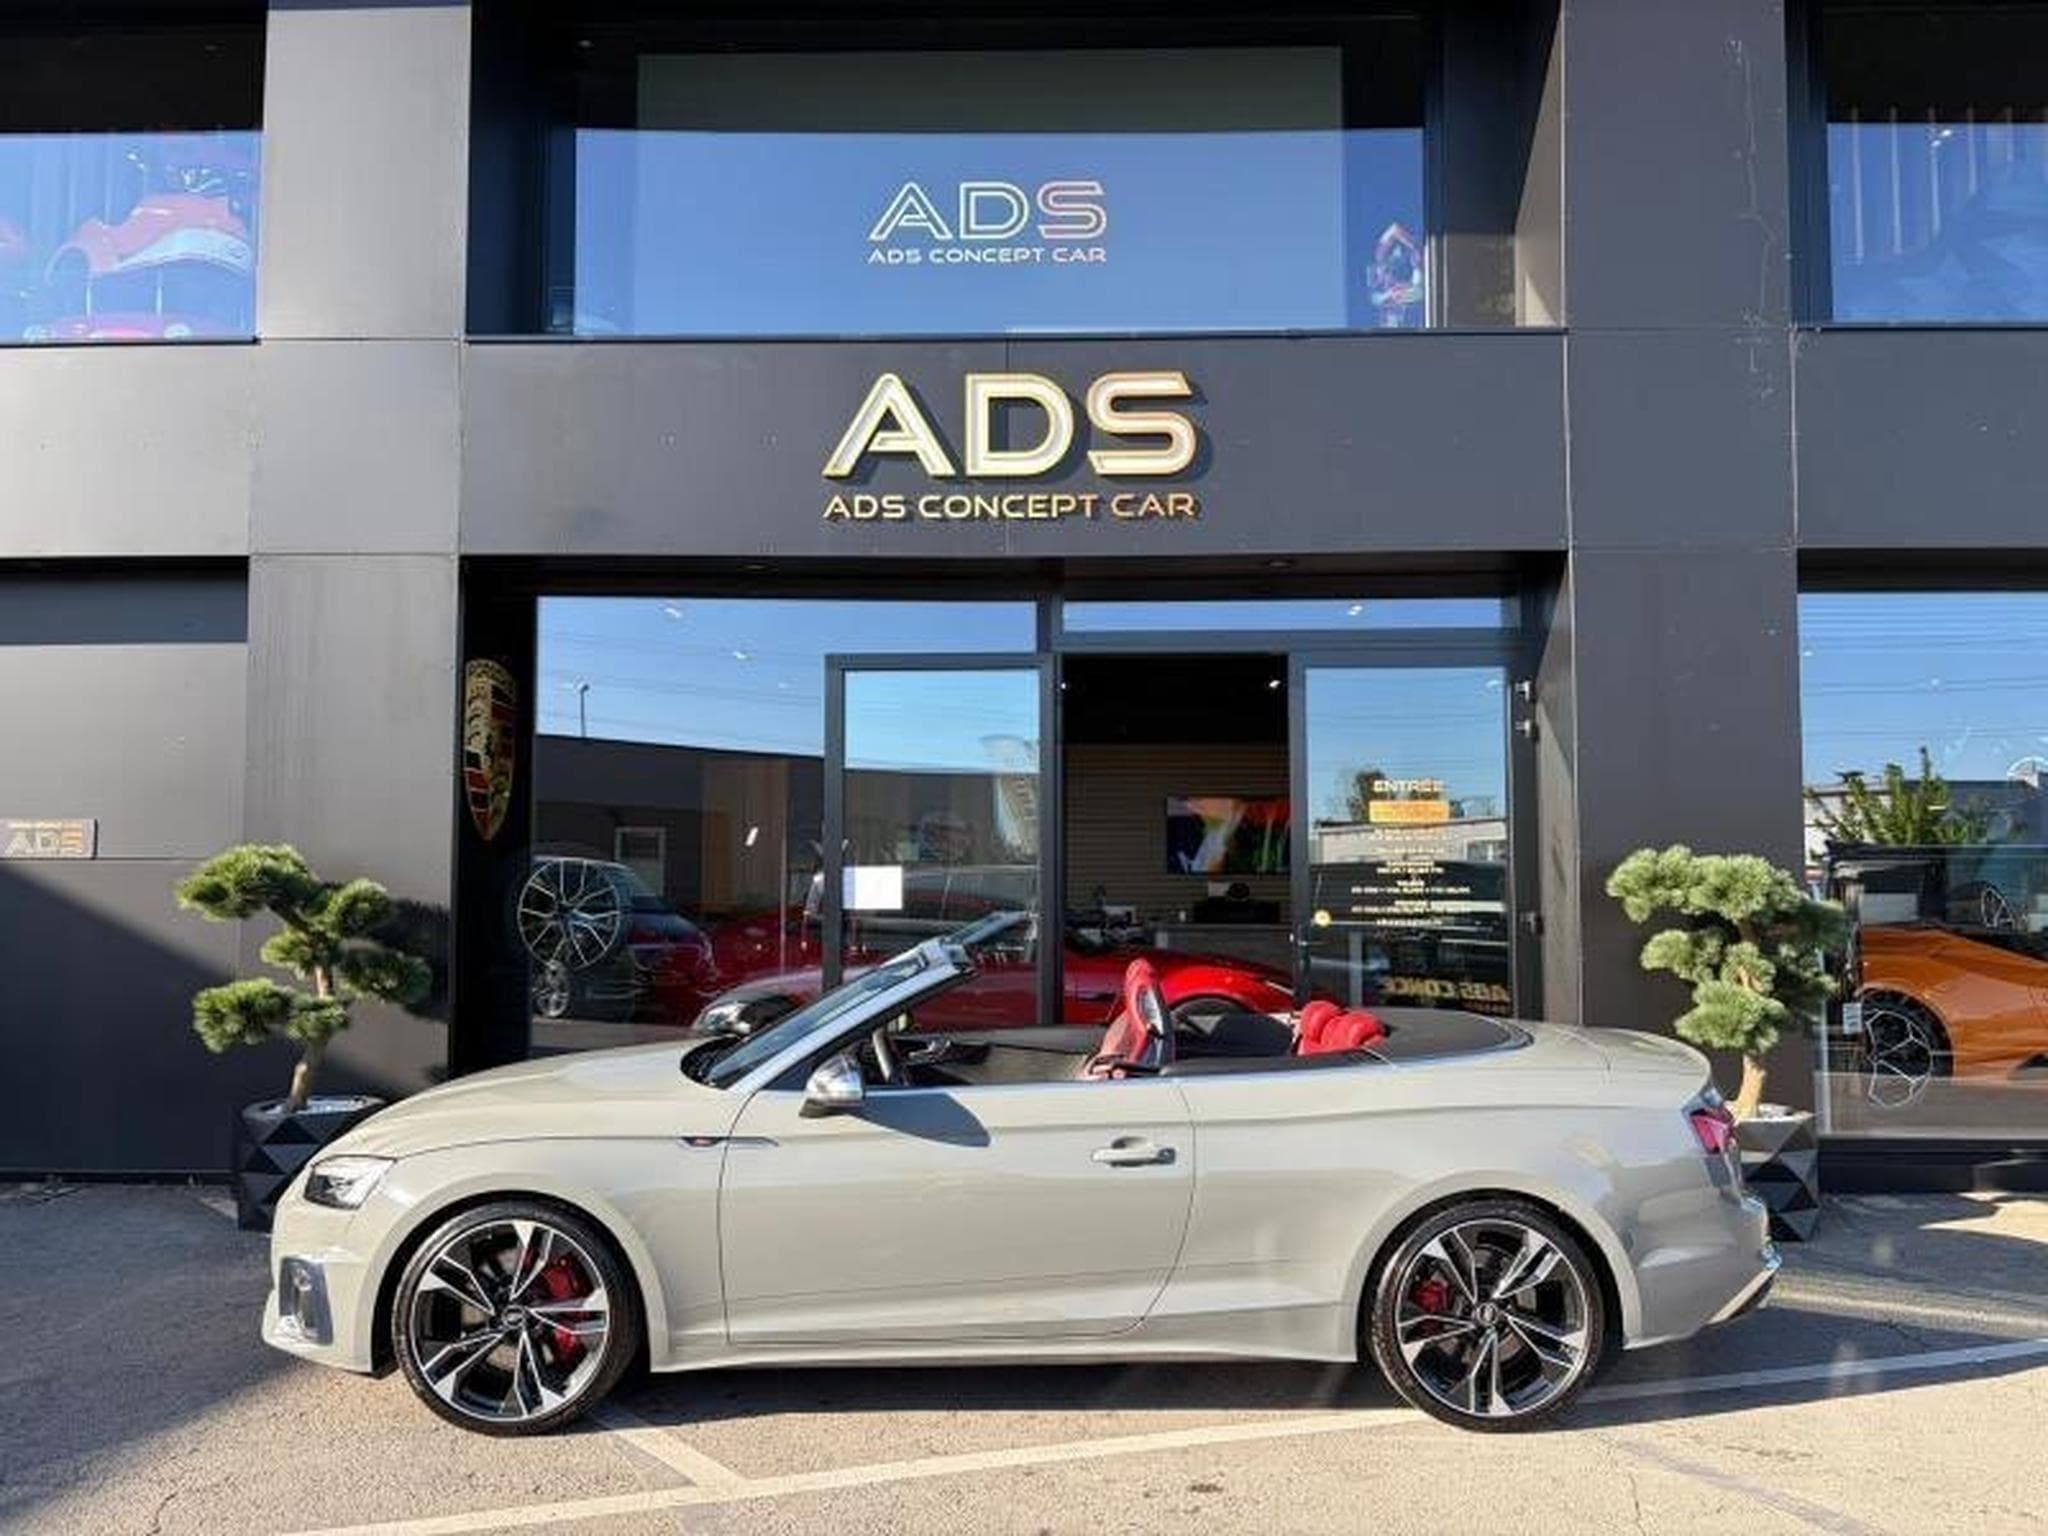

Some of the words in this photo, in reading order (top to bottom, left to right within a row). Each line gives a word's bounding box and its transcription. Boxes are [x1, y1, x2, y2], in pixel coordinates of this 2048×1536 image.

[868, 181, 1108, 241] ADS
[867, 248, 923, 264] ADS
[928, 248, 1046, 264] CONCEPT
[1051, 247, 1107, 263] CAR
[821, 372, 1197, 478] ADS
[823, 495, 906, 518] ADS
[918, 495, 1099, 518] CONCEPT
[1110, 493, 1196, 517] CAR
